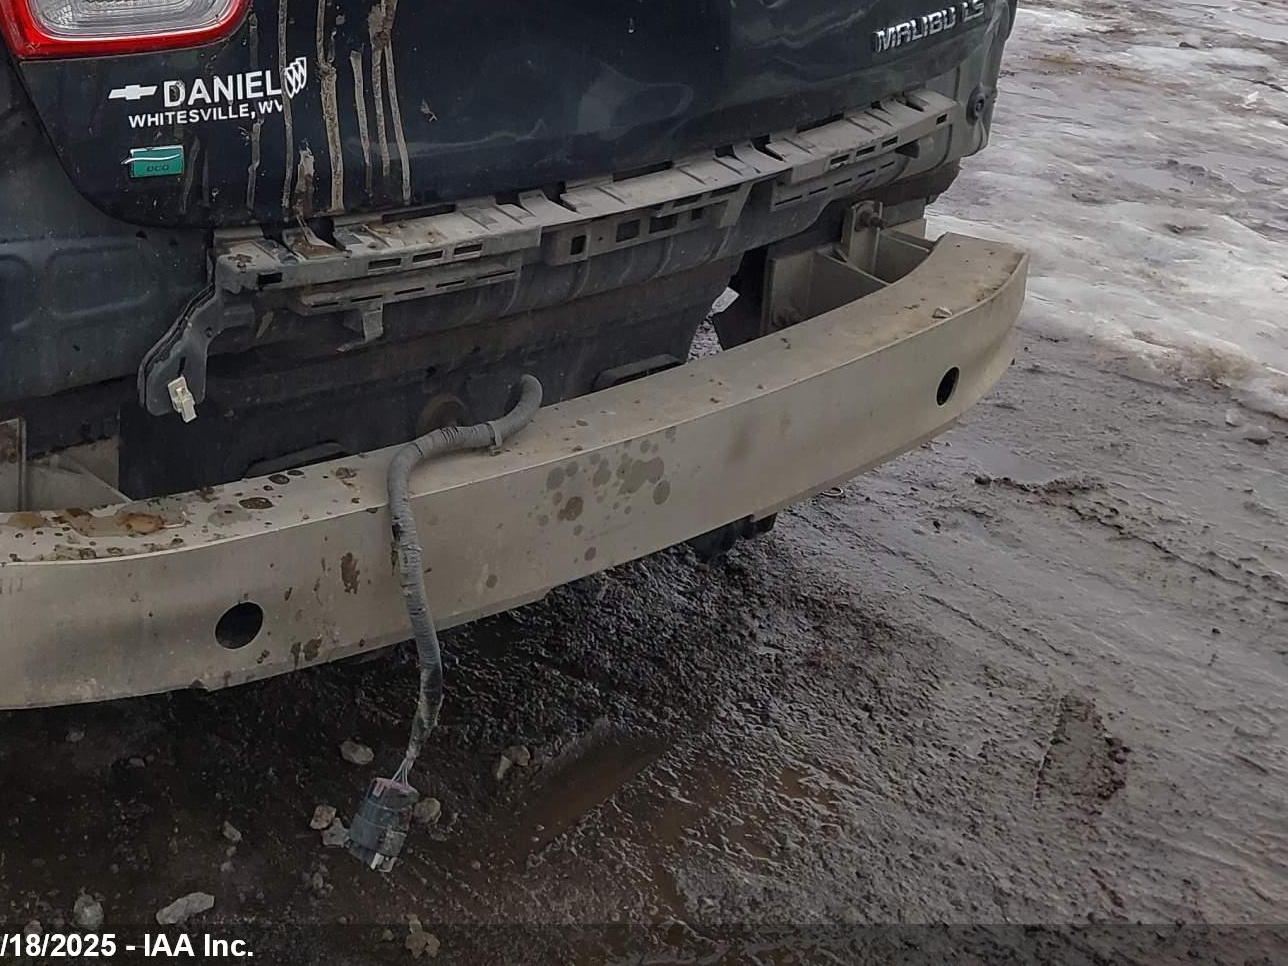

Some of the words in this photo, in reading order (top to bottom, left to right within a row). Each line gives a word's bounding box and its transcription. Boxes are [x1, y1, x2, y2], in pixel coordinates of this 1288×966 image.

[874, 7, 956, 53] MALIBU
[163, 69, 282, 108] DANIEL
[128, 103, 256, 129] WHITESVILLE,
[258, 99, 283, 115] WV
